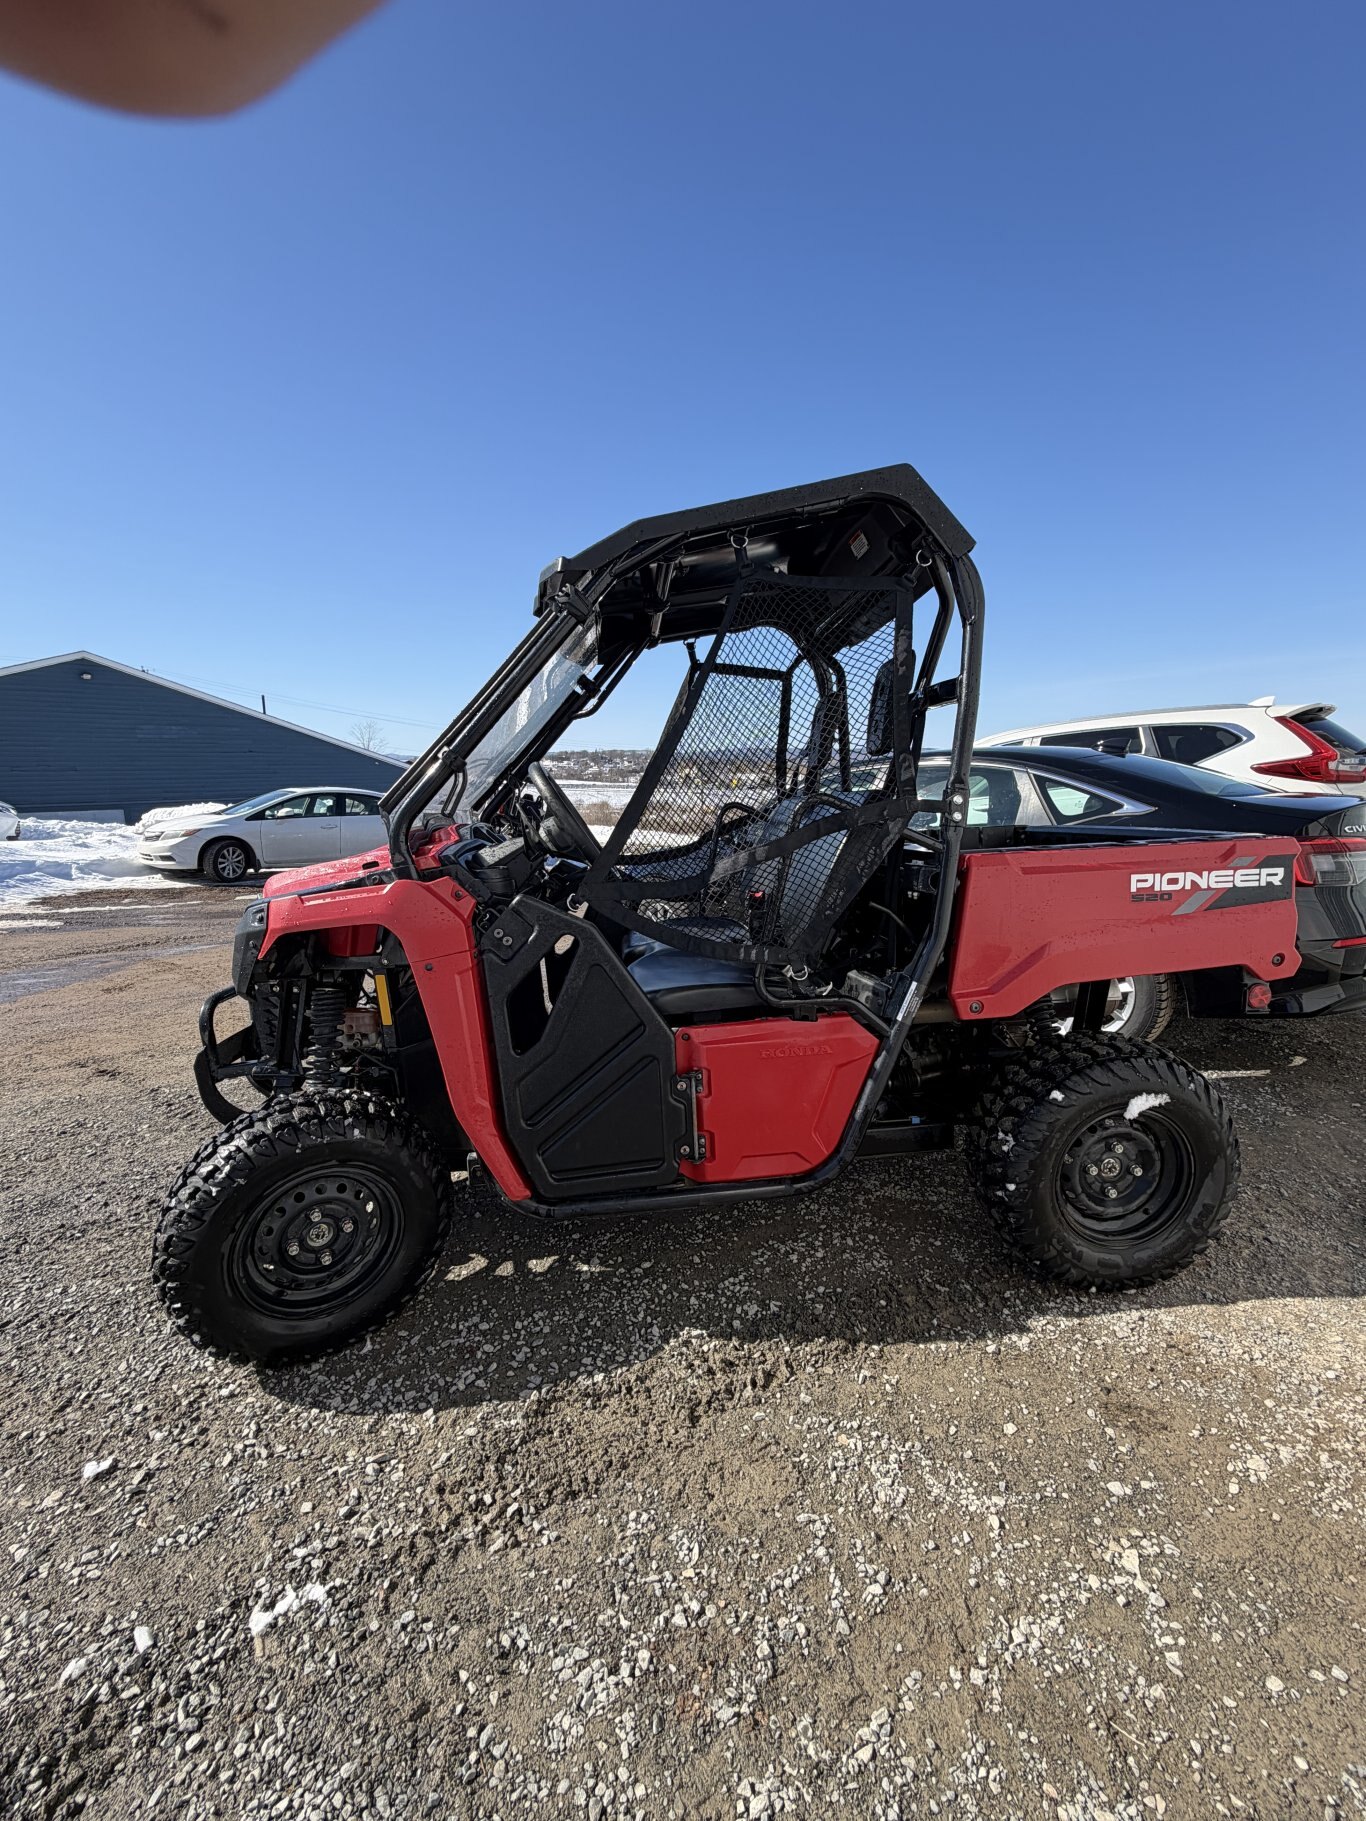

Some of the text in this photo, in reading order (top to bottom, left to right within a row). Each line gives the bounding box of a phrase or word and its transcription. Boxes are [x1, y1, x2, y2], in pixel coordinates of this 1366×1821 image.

[1130, 867, 1285, 893] PIONEER
[1131, 892, 1172, 902] 520
[760, 1045, 833, 1059] HONDA
